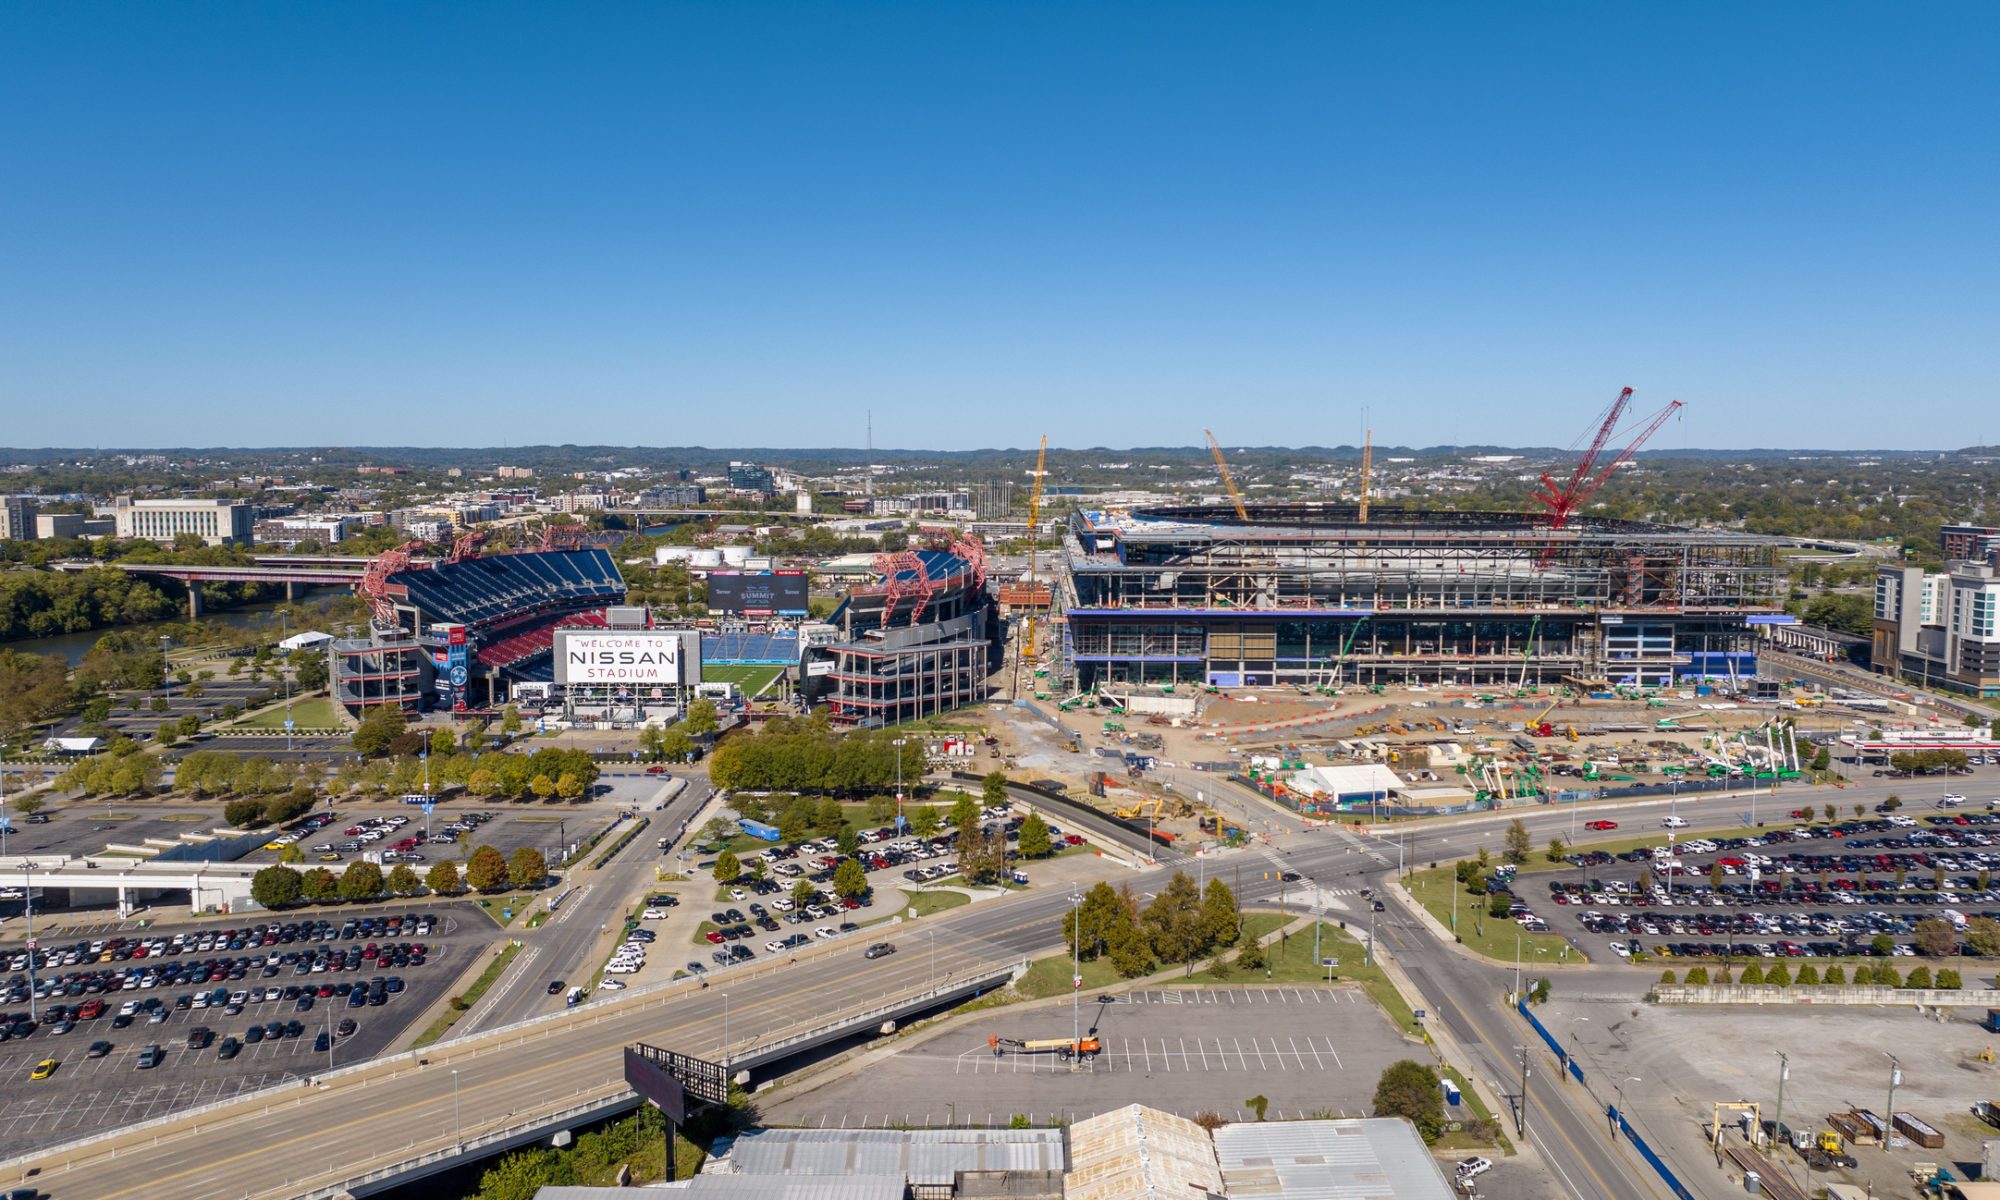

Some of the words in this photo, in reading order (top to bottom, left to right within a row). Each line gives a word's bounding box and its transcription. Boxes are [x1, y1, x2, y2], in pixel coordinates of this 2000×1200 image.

[581, 640, 640, 648] WELCOME
[648, 640, 663, 648] TO
[570, 652, 674, 664] NISSAN
[587, 668, 658, 678] STADIUM
